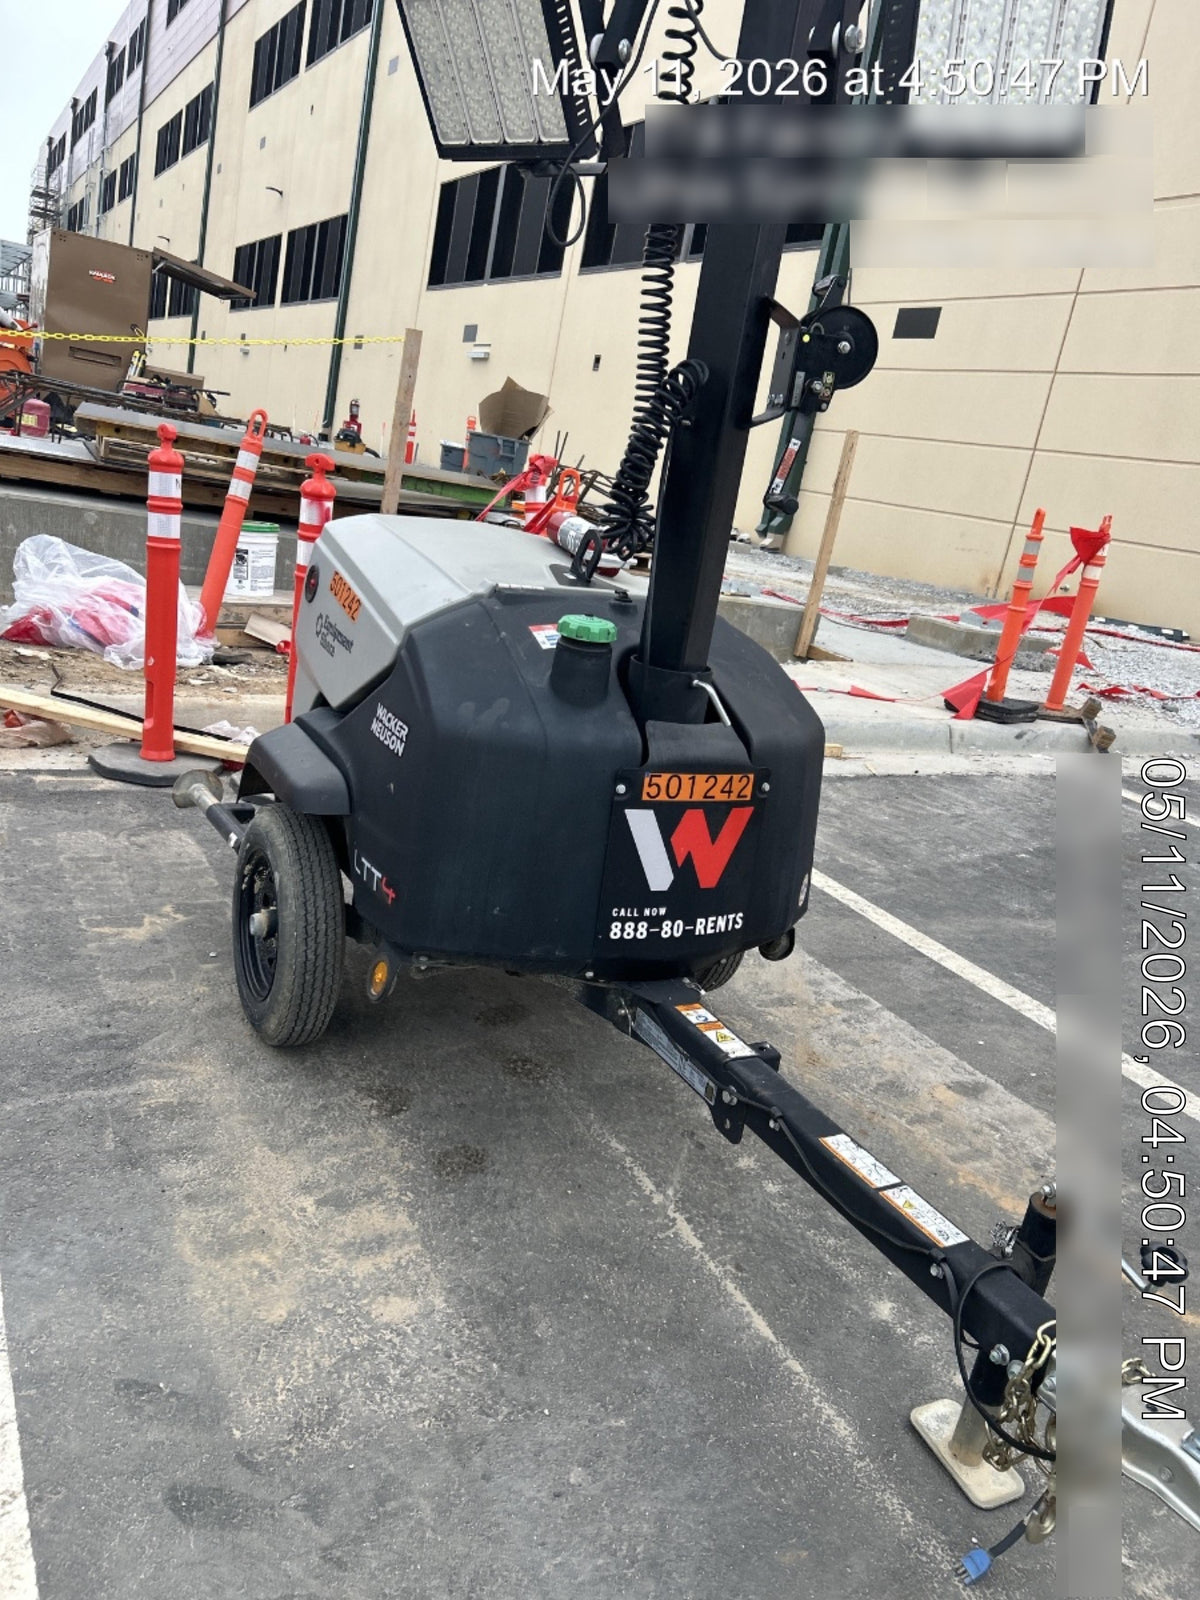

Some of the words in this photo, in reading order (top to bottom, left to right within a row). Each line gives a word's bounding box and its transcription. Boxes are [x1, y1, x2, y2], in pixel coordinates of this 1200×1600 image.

[330, 570, 362, 621] 501242
[370, 717, 406, 757] NEUSON
[375, 702, 409, 742] WACKER
[645, 774, 751, 800] 501242
[608, 912, 745, 940] 888-80-RENTS
[611, 907, 640, 917] CALL
[643, 906, 668, 917] NOW
